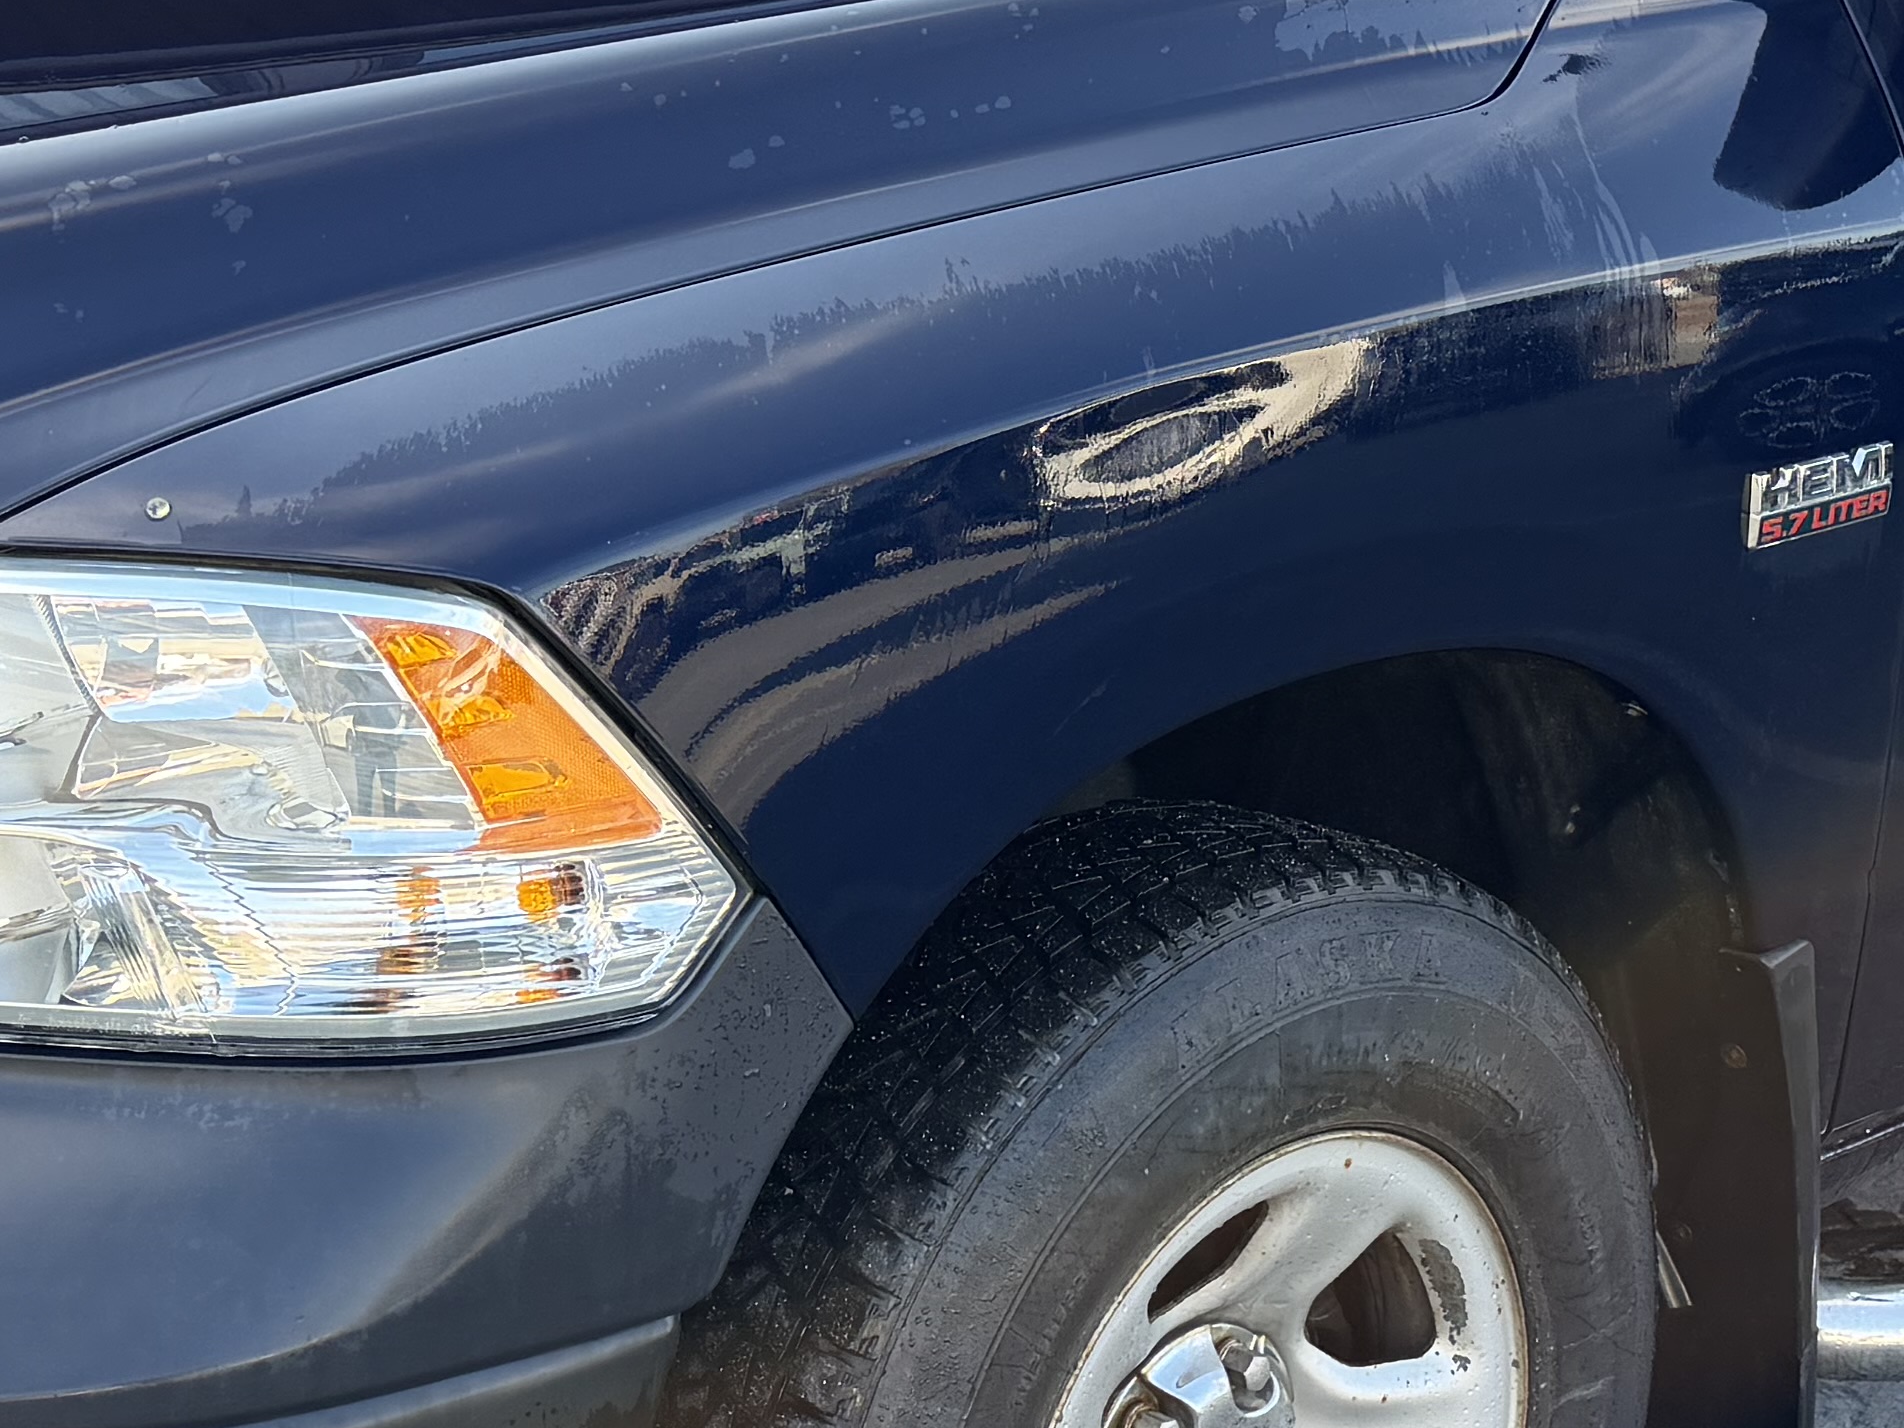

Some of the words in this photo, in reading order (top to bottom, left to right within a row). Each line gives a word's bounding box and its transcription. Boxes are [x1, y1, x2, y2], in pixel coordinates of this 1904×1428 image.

[1744, 441, 1895, 516] HEMI
[1761, 510, 1810, 544] 5.7
[1811, 488, 1889, 531] LITER
